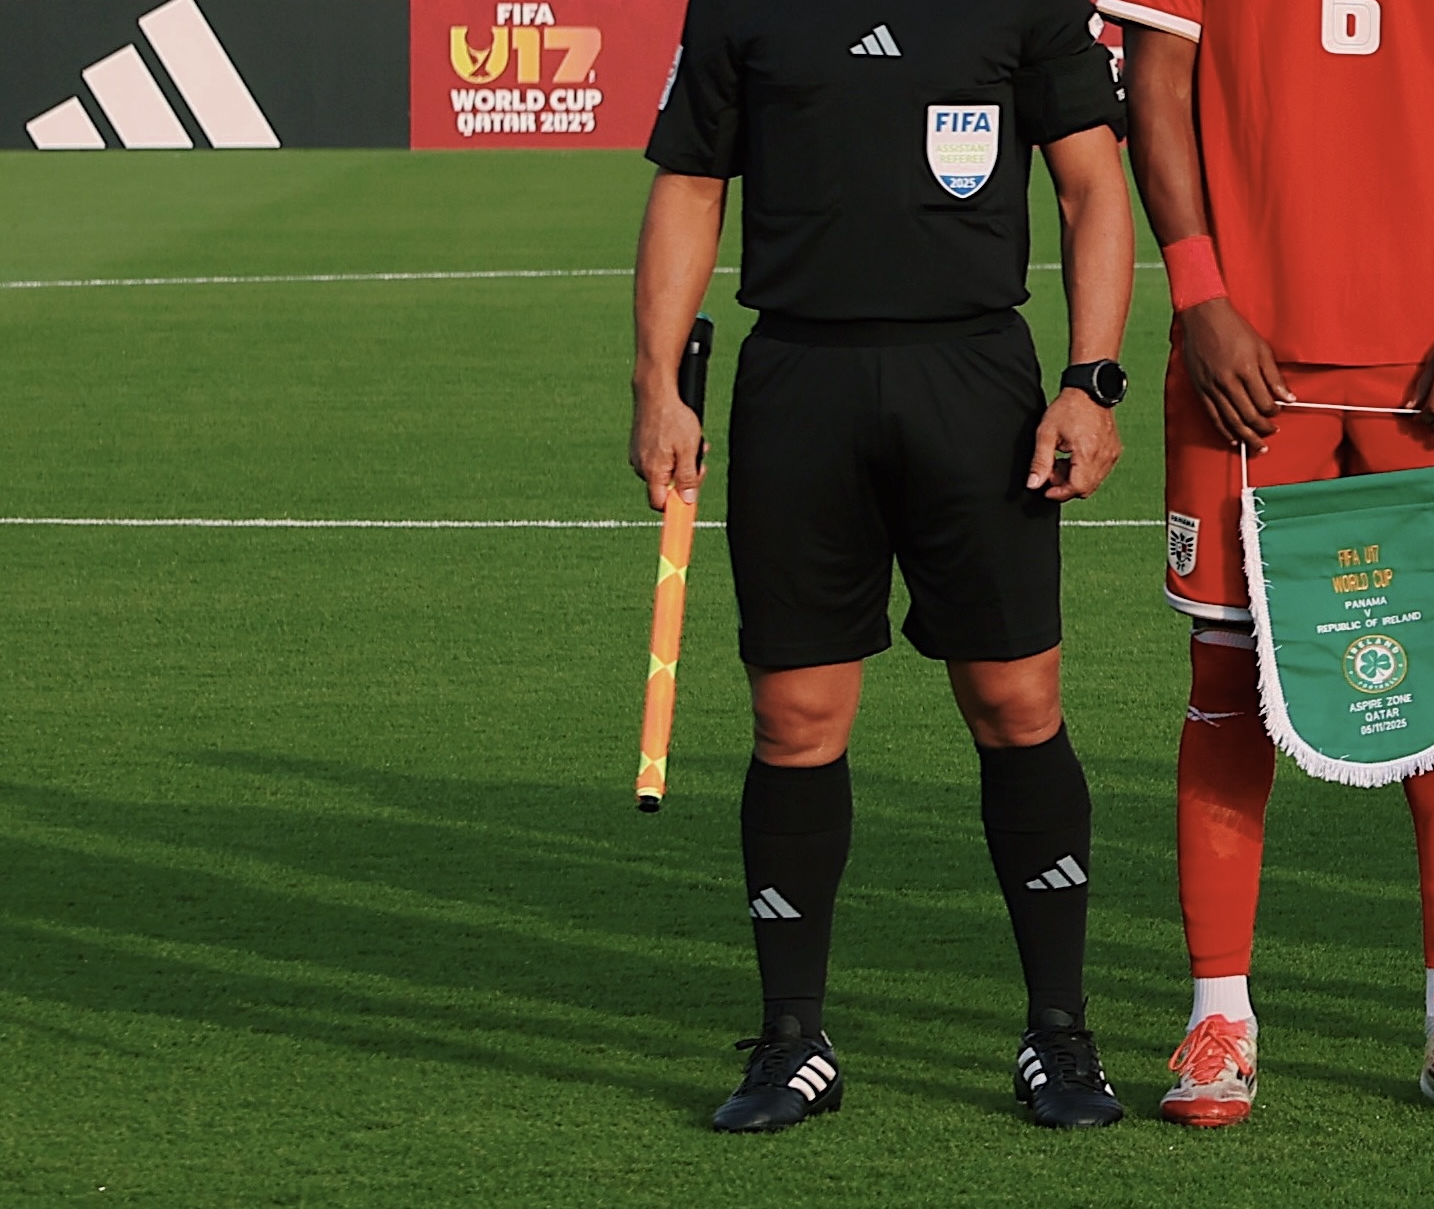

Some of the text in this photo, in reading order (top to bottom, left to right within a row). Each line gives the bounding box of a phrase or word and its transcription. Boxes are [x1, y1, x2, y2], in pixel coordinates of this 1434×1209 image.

[496, 2, 556, 26] FIFA
[450, 25, 602, 85] U17
[450, 88, 603, 113] WORLD CUP
[457, 111, 596, 137] QATAR 2025
[936, 112, 991, 132] FIFA
[936, 143, 991, 153] ASSISTANT
[939, 154, 986, 164] REFEREE
[950, 177, 977, 189] 2025
[1332, 569, 1393, 593] WORLD CUP
[1345, 596, 1387, 609] PANAMA
[1316, 611, 1422, 634] REPUBLIC OF IRELAND
[1346, 637, 1400, 659] IRELAND
[1349, 693, 1413, 712] ASPIRE ZONE
[1365, 707, 1400, 722] QATAR
